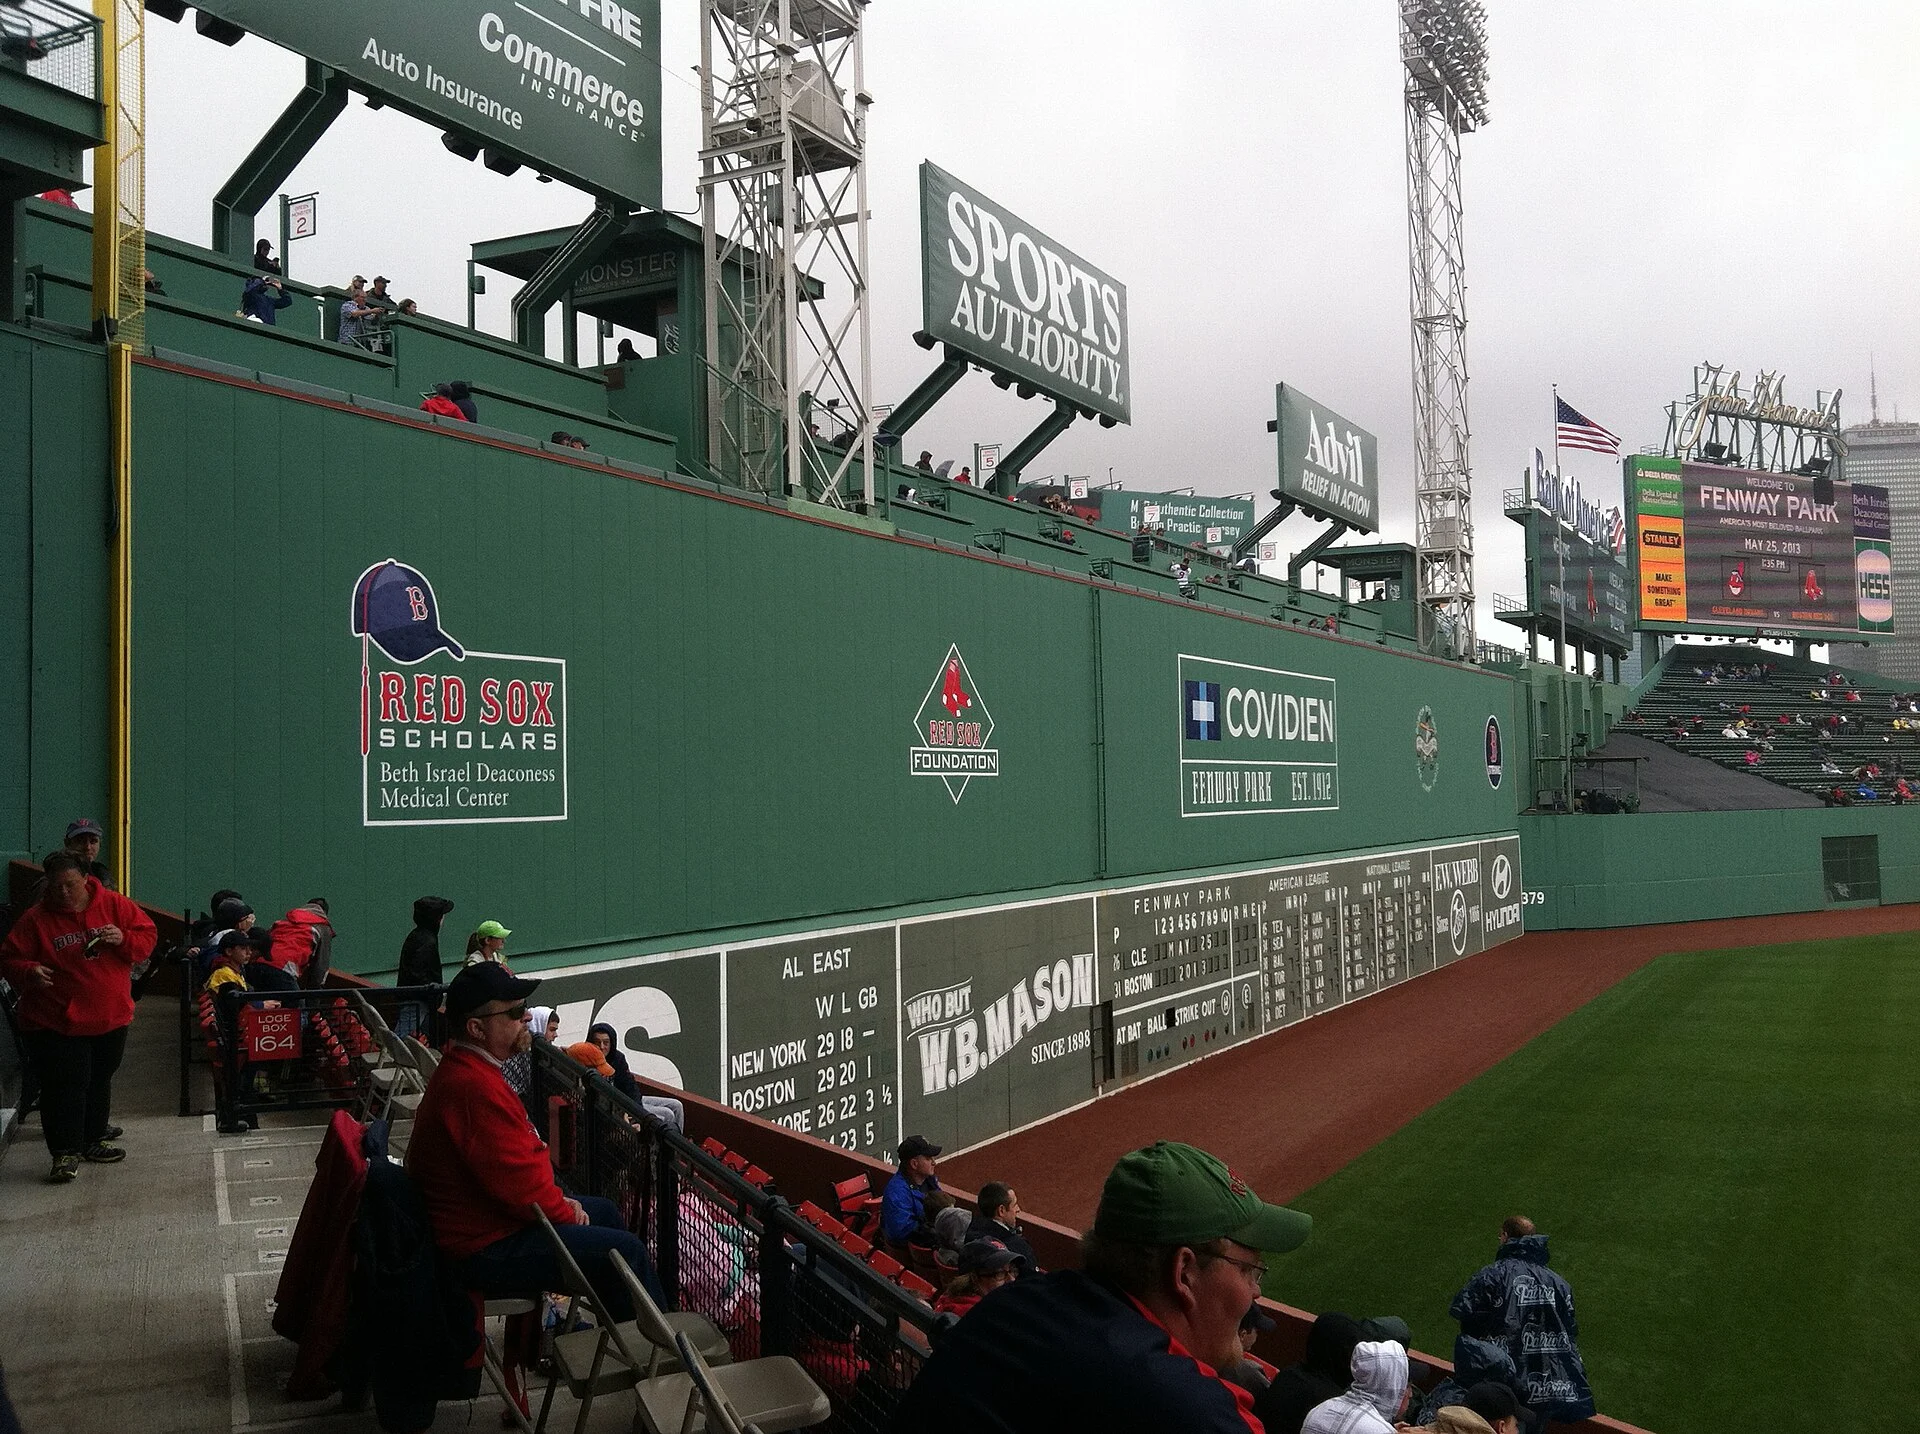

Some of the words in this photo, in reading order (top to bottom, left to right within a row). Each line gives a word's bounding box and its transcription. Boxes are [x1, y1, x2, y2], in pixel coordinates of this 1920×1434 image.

[479, 13, 644, 126] Commerce
[362, 37, 419, 82] Auto
[426, 64, 523, 130] Insurance
[520, 73, 638, 142] INSURANCE
[297, 217, 306, 234] 2
[947, 191, 1121, 355] SPORTS
[950, 280, 1122, 403] AUTHORITY
[1675, 360, 1747, 450] John
[1750, 369, 1849, 457] Hancock
[1304, 409, 1364, 488] Advil
[986, 457, 995, 468] 5
[1074, 488, 1083, 497] 6
[1301, 469, 1329, 499] RELIEF
[1329, 482, 1341, 504] IN
[1340, 487, 1371, 518] ACTION
[1745, 477, 1783, 490] WELCOME
[1784, 481, 1794, 492] TO
[1158, 501, 1197, 517] uthentic
[1199, 505, 1244, 520] Collection
[1700, 485, 1780, 517] FENWAY
[1787, 495, 1840, 524] PARK
[1853, 494, 1868, 505] Beth
[1870, 495, 1889, 507] Israel
[1148, 513, 1155, 521] 7
[1853, 506, 1890, 520] Deaconess
[1167, 519, 1201, 533] Practic
[1210, 533, 1217, 541] 8
[1752, 520, 1768, 529] MOST
[1769, 523, 1794, 532] BELOVED
[1645, 533, 1680, 545] STANLEY
[1745, 538, 1763, 550] MAY
[1766, 540, 1780, 554] 25,
[1782, 542, 1801, 555] 2013
[1776, 560, 1786, 569] PM
[1655, 573, 1672, 582] MAKE
[1859, 572, 1891, 600] HESS
[1647, 585, 1681, 595] SOMETHING
[405, 586, 428, 621] B
[378, 671, 467, 725] RED
[479, 677, 556, 727] SOX
[1226, 687, 1334, 743] COVIDIEN
[379, 728, 557, 750] SCHOLARS
[929, 720, 955, 745] RED
[956, 721, 982, 747] SOX
[380, 761, 419, 783] Beth
[426, 762, 471, 783] Israel
[476, 762, 556, 783] Deaconess
[914, 753, 996, 770] FOUNDATION
[380, 786, 450, 808] Medical
[456, 786, 509, 807] Center
[1192, 771, 1240, 805] FENWAY
[1244, 771, 1273, 802] PARK
[1291, 772, 1311, 801] EST.
[1312, 771, 1332, 801] 1912
[1366, 863, 1392, 876] NATIONAL
[1392, 860, 1411, 872] LEAGUE
[1268, 875, 1303, 892] AMERICAN
[1305, 871, 1330, 887] LEAGUE
[1134, 892, 1189, 915] FENWAY
[1199, 886, 1231, 905] PARK
[1521, 892, 1545, 905] 379
[1272, 920, 1283, 934] TEX
[1485, 903, 1521, 933] HYUNDAI
[1113, 927, 1120, 944] P
[1272, 936, 1284, 951] SEA
[782, 956, 804, 979] AL
[813, 947, 851, 974] EAST
[1131, 947, 1147, 967] CLE
[1113, 980, 1122, 999] 31
[1124, 973, 1153, 996] BOSTON
[815, 994, 834, 1019] W
[842, 992, 851, 1013] L
[858, 986, 878, 1009] GB
[906, 993, 942, 1029] WHO
[945, 984, 972, 1018] BUT
[258, 1014, 292, 1023] LOGE
[262, 1024, 288, 1033] BOX
[1116, 1025, 1125, 1045] AT
[1127, 1021, 1141, 1042] BAT
[1147, 1013, 1167, 1034] BALL
[1175, 1003, 1199, 1026] STRIKE
[1201, 998, 1216, 1017] OUT
[255, 1034, 295, 1052] 164
[731, 1049, 764, 1079] NEW
[770, 1038, 807, 1069] YORK
[817, 1032, 834, 1058] 29
[841, 1027, 853, 1052] 18
[1031, 1038, 1065, 1065] SINCE
[1067, 1029, 1091, 1053] 1898
[732, 1077, 796, 1112] BOSTON
[817, 1067, 835, 1093] 29
[839, 1060, 856, 1086] 20
[818, 1100, 835, 1128] 26
[840, 1094, 856, 1120] 22
[866, 1089, 874, 1112] 3
[840, 1128, 857, 1151] 23
[866, 1121, 875, 1146] 5
